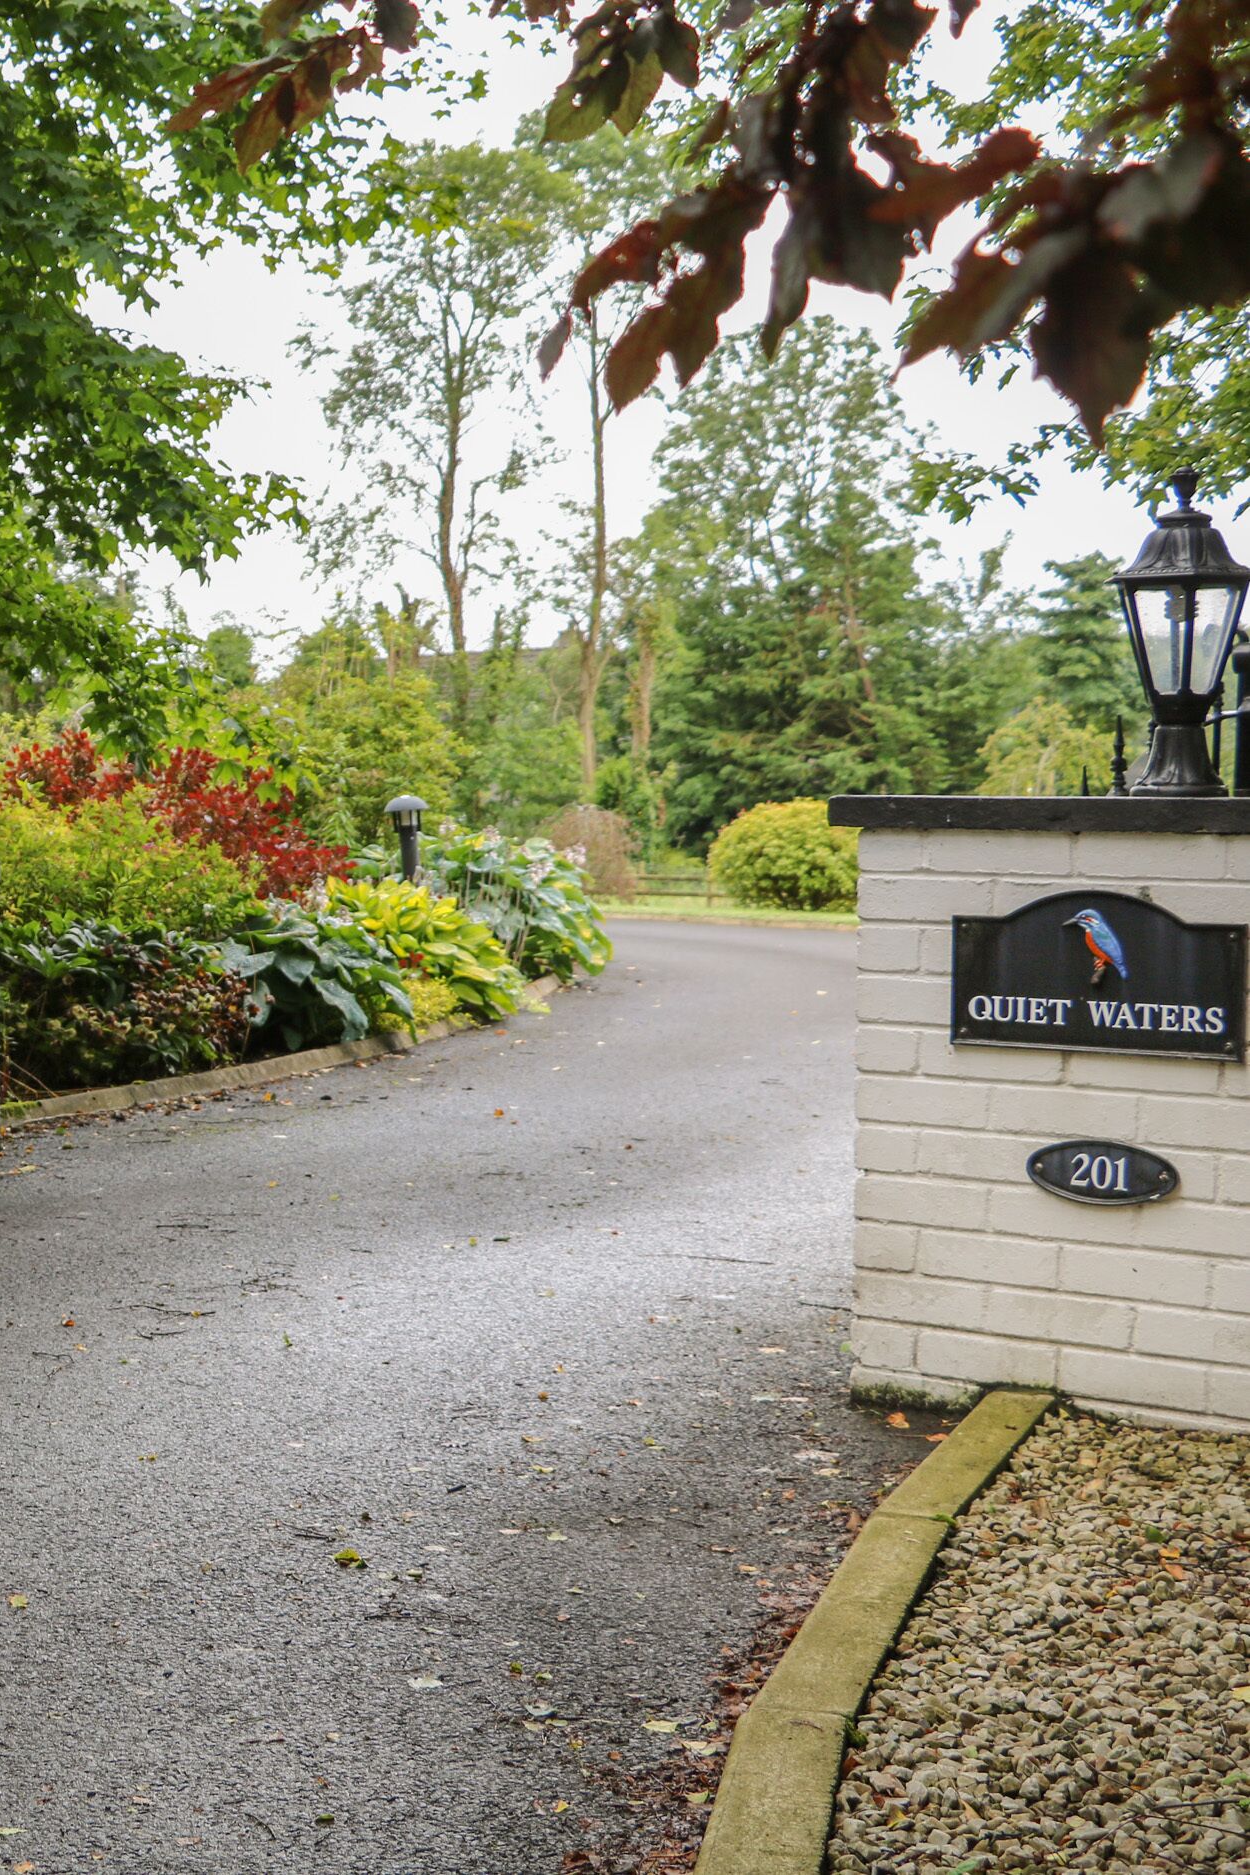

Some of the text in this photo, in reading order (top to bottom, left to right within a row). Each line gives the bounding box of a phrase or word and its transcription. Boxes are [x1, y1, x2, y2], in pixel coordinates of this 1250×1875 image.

[968, 995, 1224, 1033] QUIET WATERS
[1070, 1153, 1128, 1191] 201
